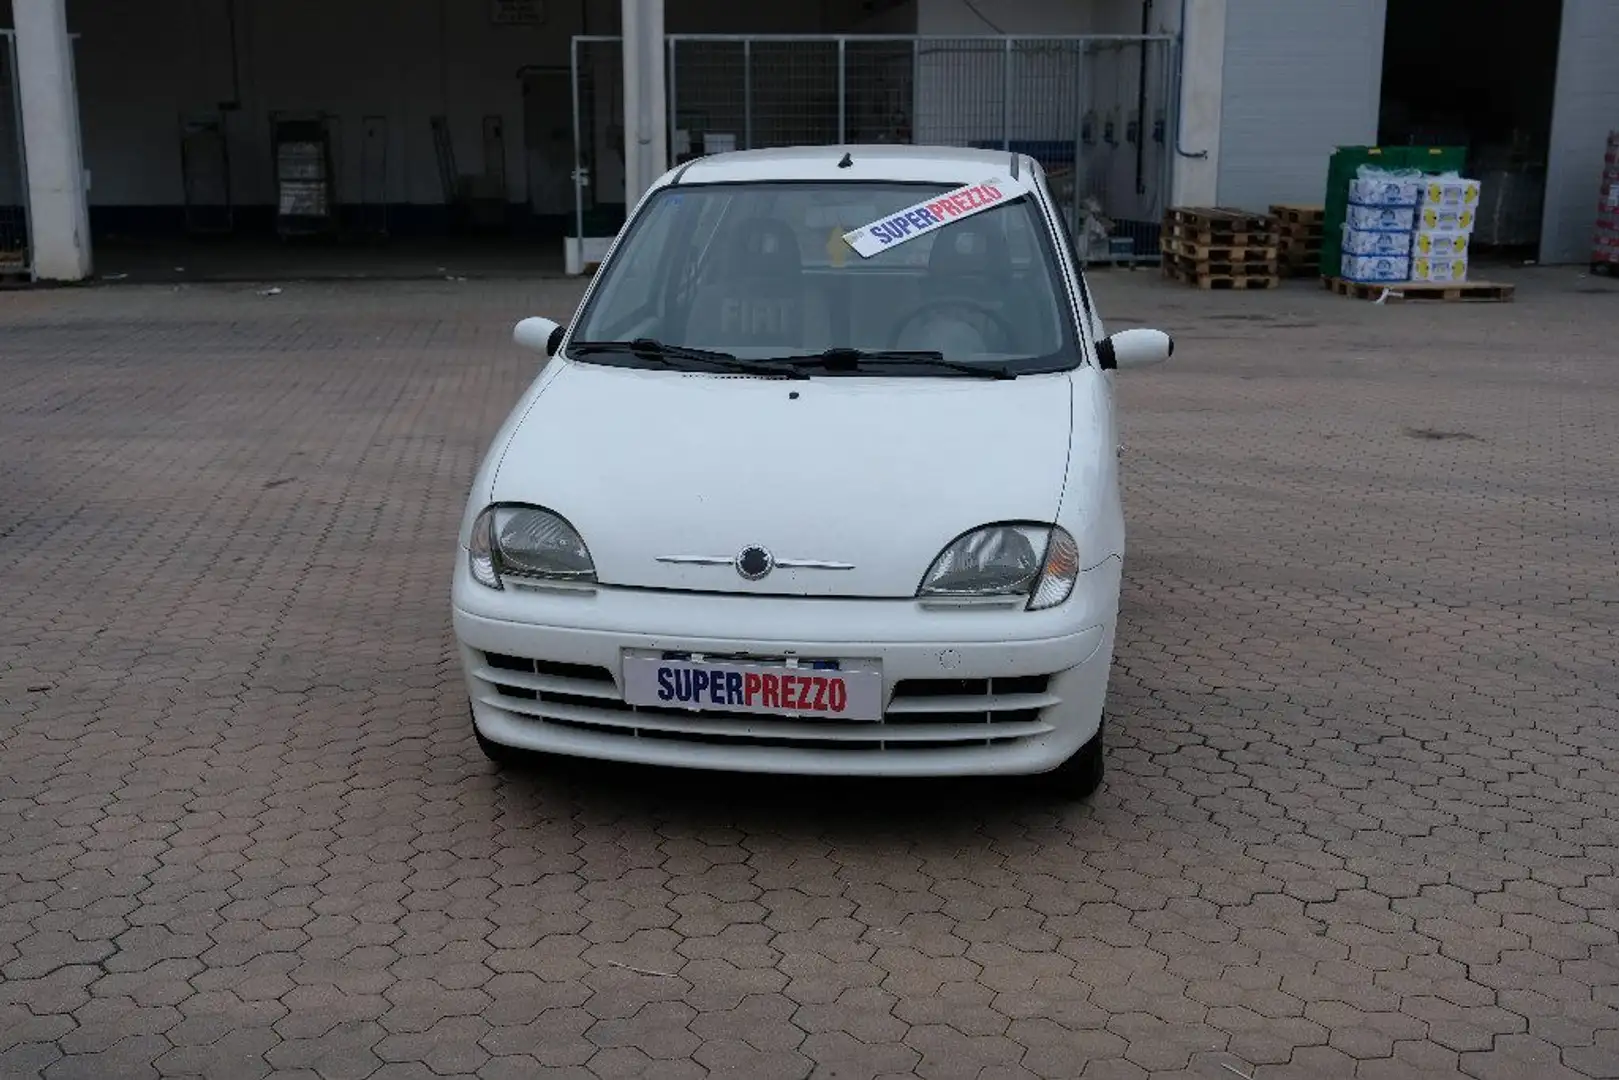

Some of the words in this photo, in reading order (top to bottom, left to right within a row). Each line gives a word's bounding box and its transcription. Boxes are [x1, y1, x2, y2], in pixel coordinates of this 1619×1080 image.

[870, 184, 1003, 244] SUPERPREZZO
[721, 298, 795, 335] FIAT
[658, 667, 847, 713] SUPERPREZZO
